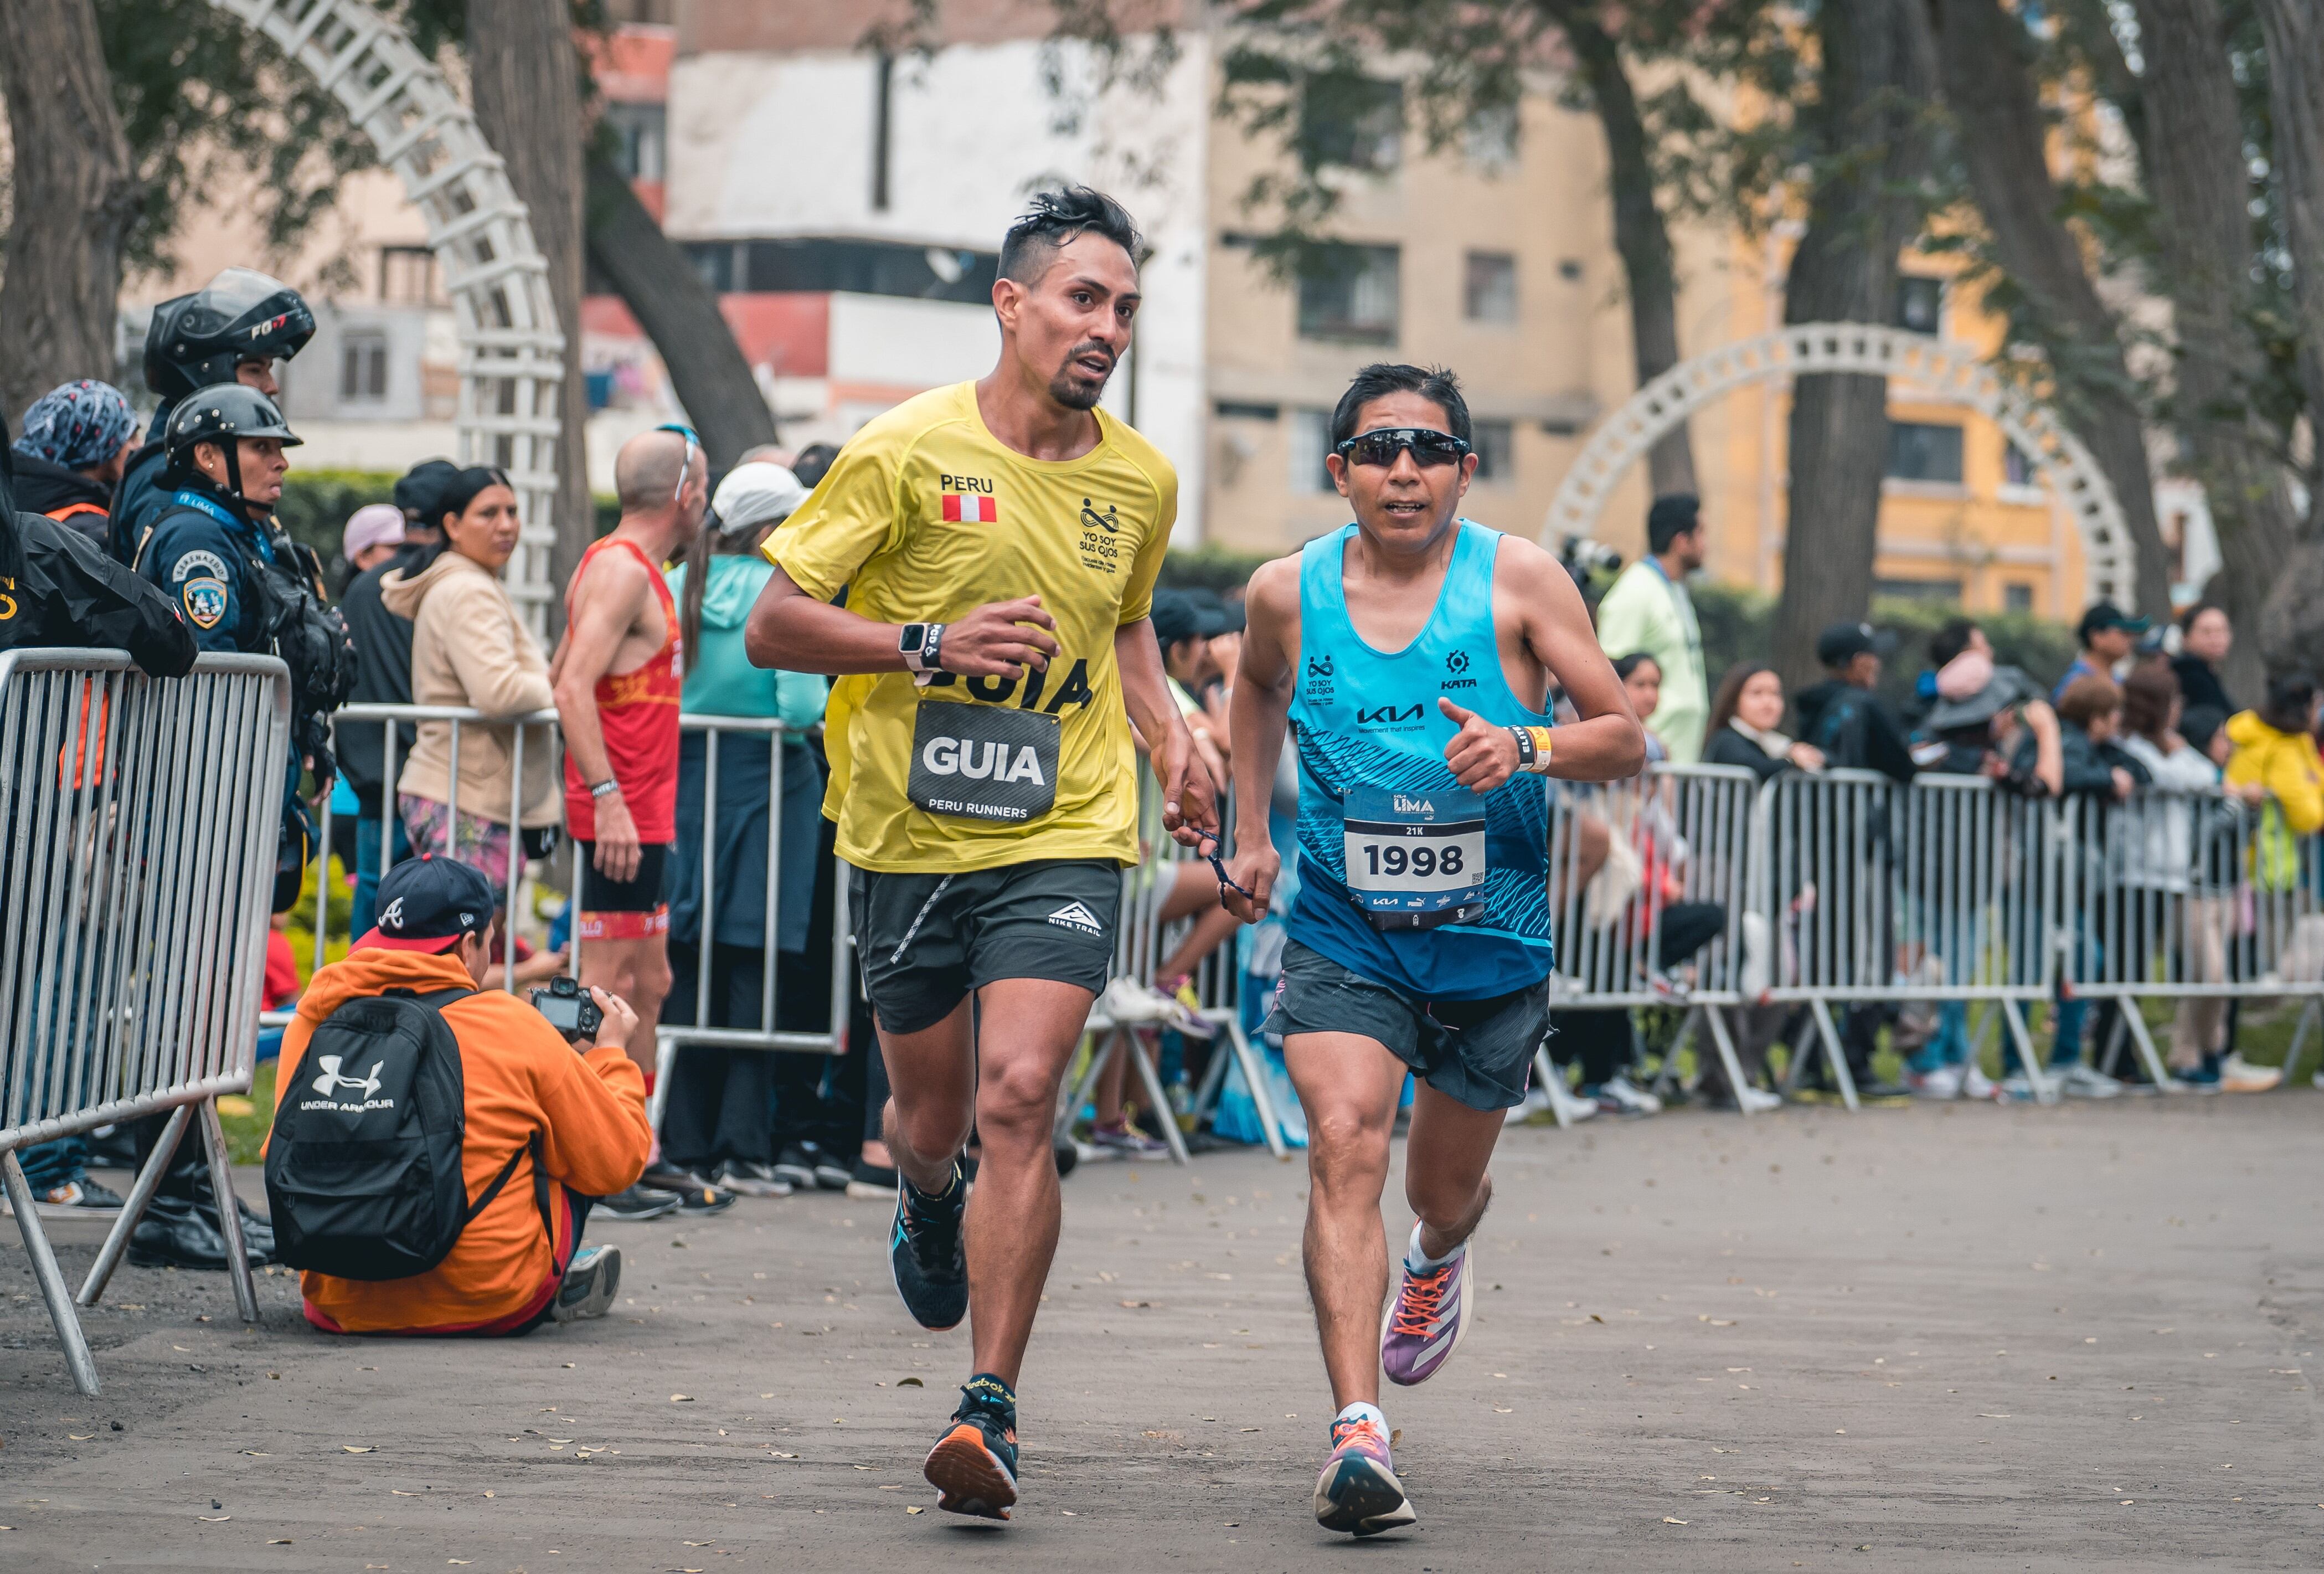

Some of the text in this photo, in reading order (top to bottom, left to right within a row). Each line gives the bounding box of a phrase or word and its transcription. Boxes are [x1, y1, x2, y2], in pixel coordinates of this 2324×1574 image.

[940, 474, 993, 493] PERU
[1083, 531, 1116, 547] YO SOY
[1079, 541, 1118, 558] SUS OJOS
[929, 624, 942, 644] PCD
[1317, 687, 1334, 696] OJOS
[1441, 678, 1477, 690] KATA
[923, 736, 1045, 786] GUIA
[929, 799, 1028, 819] PERU RUNNERS
[1394, 798, 1435, 812] LIMA
[1406, 826, 1424, 836] 21K
[1363, 845, 1464, 877] 1998
[1048, 918, 1101, 937] NIKE TRAIL
[301, 1100, 338, 1110] UNDER
